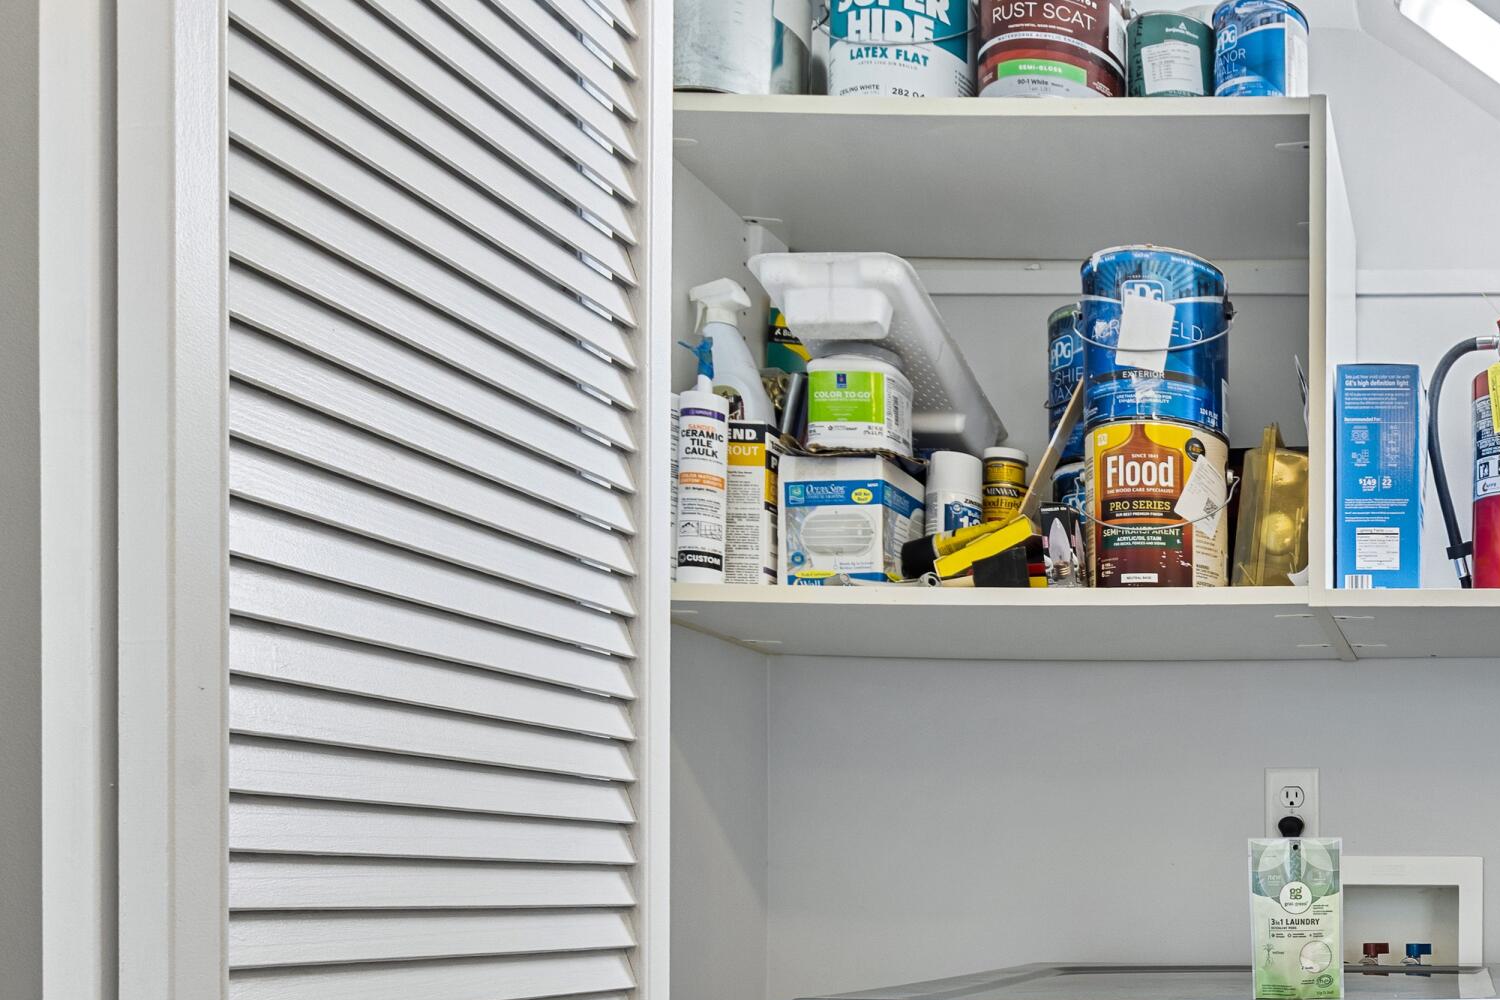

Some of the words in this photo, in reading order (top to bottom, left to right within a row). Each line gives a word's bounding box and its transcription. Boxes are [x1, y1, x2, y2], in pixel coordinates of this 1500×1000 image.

[993, 1, 1038, 24] RUST
[1042, 2, 1097, 31] SCAT
[847, 8, 935, 44] HIDE
[1217, 27, 1237, 51] PPG
[850, 46, 888, 60] LATEX
[896, 48, 929, 67] FLAT
[1018, 64, 1063, 73] SEMI-GLOSS
[892, 87, 910, 97] 282
[1051, 341, 1072, 366] PPG
[1122, 370, 1165, 379] EXTERIOR
[814, 391, 842, 399] COLOR
[845, 391, 856, 399] TO
[857, 391, 871, 399] GO
[681, 429, 724, 443] CERAMIC
[691, 438, 713, 448] TILE
[684, 447, 719, 458] CAULK
[1106, 455, 1174, 488] Flood
[1382, 478, 1392, 486] 22
[986, 487, 1018, 497] MINWAX
[983, 498, 999, 508] ood
[1109, 501, 1130, 511] PRO
[1132, 500, 1171, 510] SERIES
[686, 553, 721, 566] CUSTOM
[1286, 918, 1320, 926] LAUNDRY
